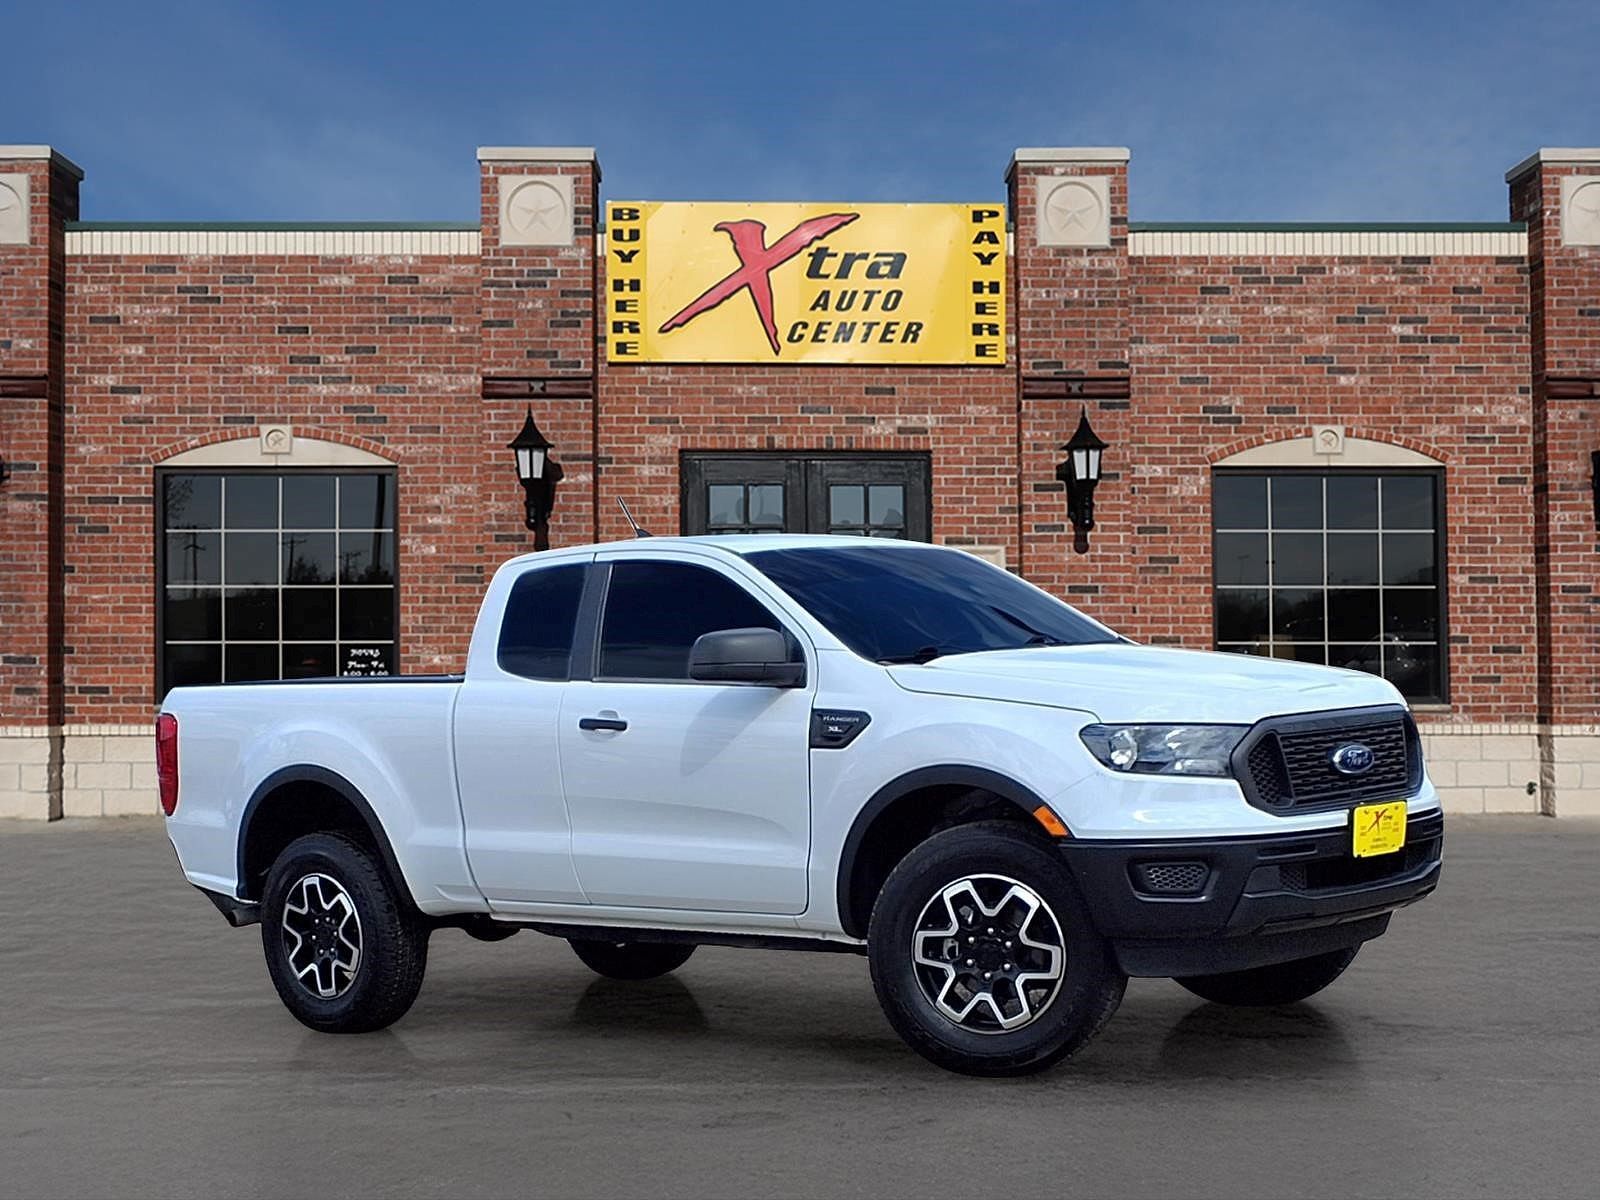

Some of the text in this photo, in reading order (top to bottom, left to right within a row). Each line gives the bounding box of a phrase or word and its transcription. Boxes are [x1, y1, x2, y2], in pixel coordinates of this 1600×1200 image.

[612, 207, 640, 356] BUY HERE
[972, 209, 1000, 358] PAY HERE
[810, 289, 904, 312] AUTO
[786, 321, 924, 344] CENTER
[1345, 749, 1369, 767] Ford
